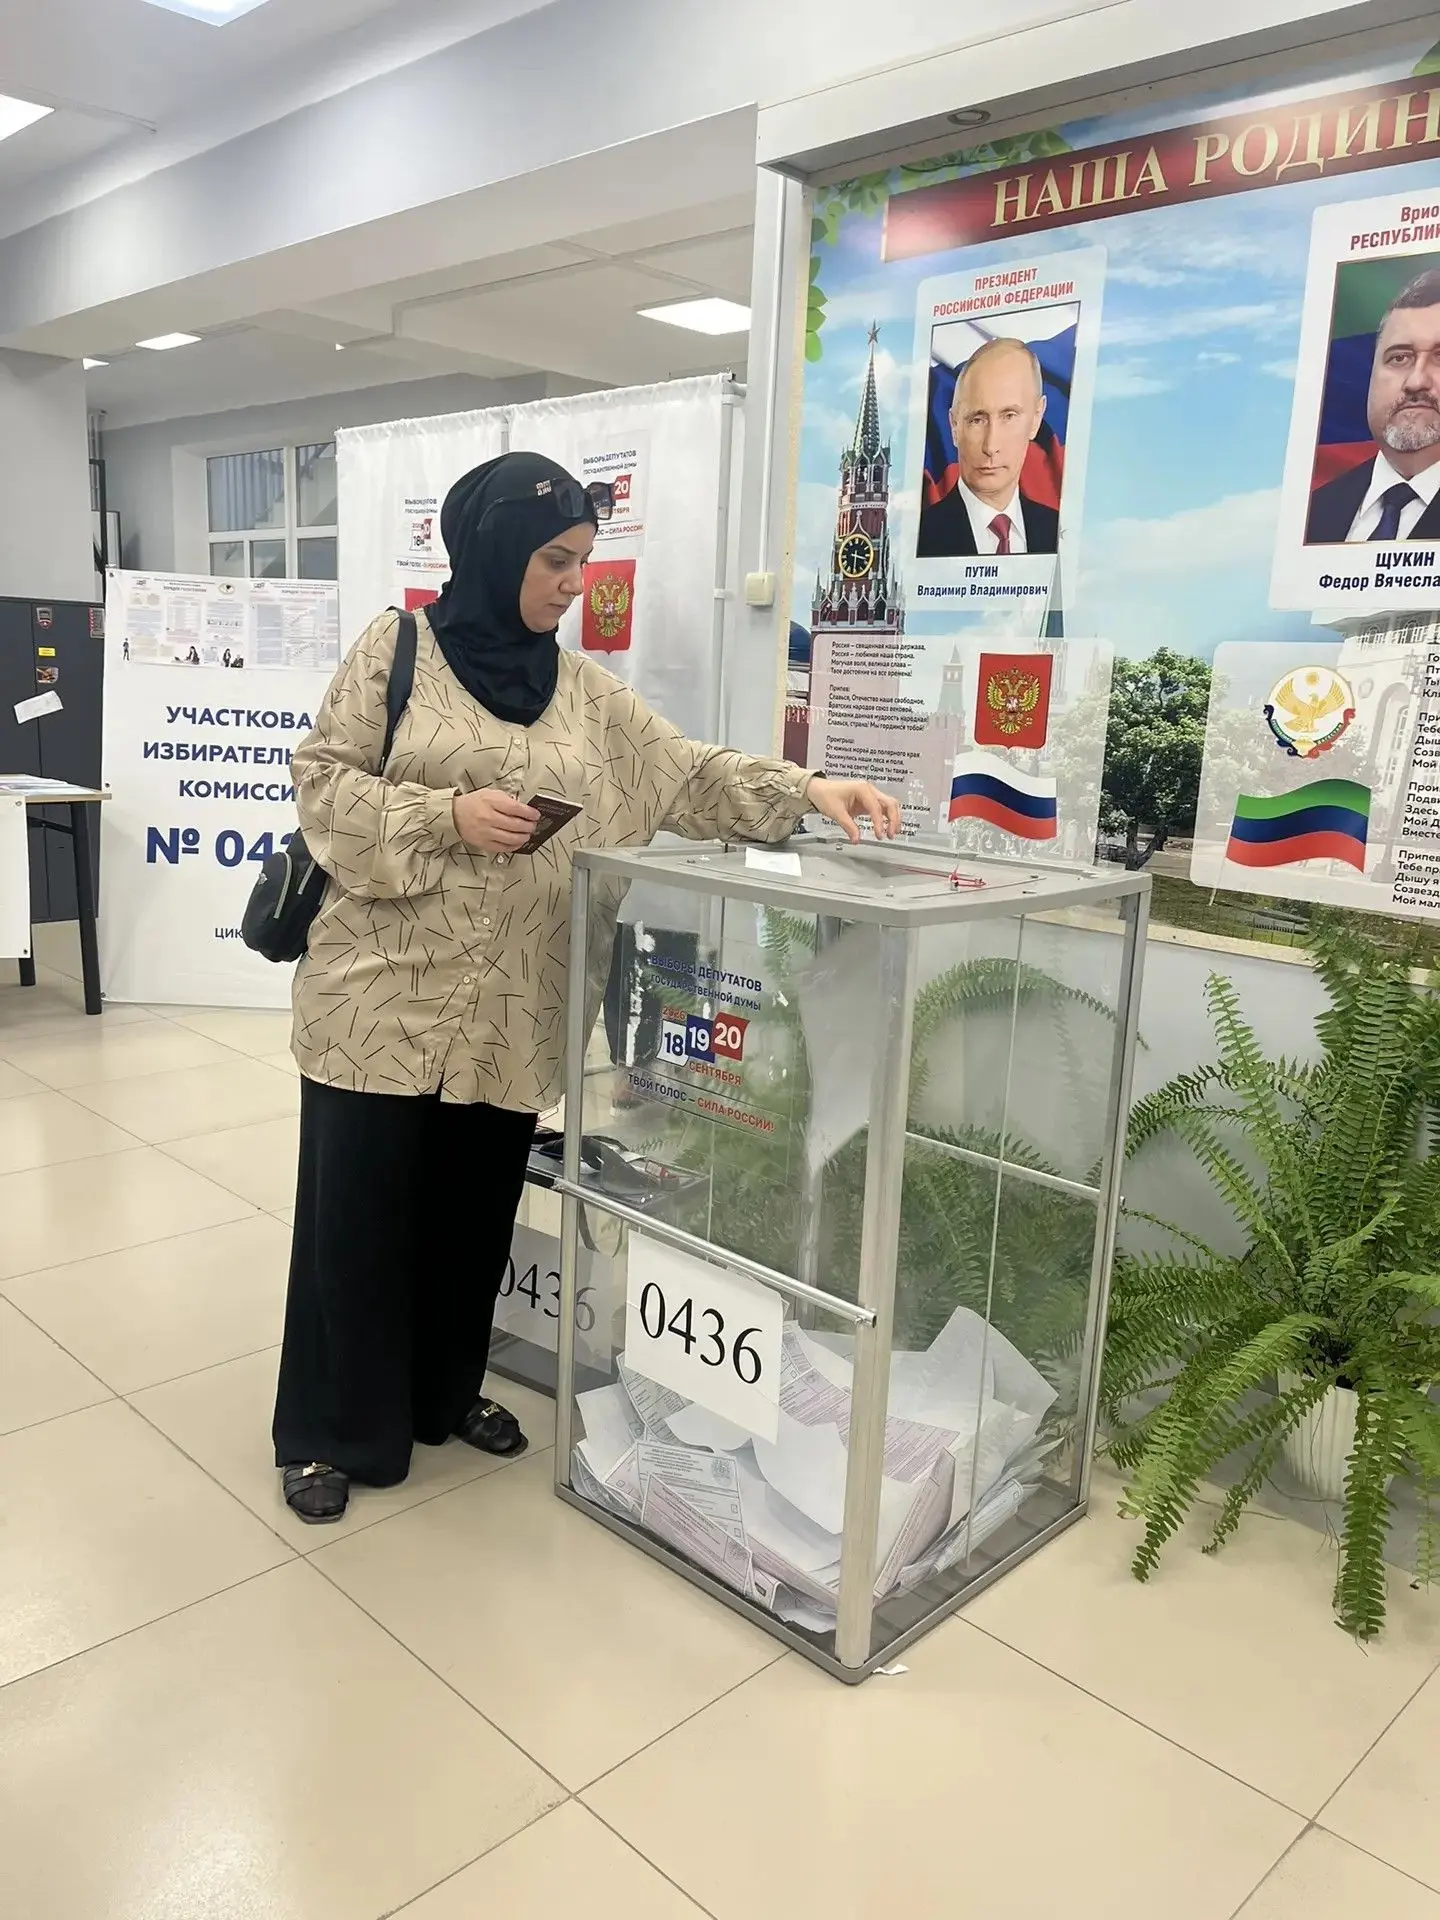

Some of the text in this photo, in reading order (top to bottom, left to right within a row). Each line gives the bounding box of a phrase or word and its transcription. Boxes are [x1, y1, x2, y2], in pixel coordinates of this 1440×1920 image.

[990, 89, 1440, 227] НАША РОДИН
[1401, 206, 1439, 224] Врио
[975, 268, 1038, 291] ПРЕЗИДЕНТ
[934, 281, 1074, 317] РОССИЙСКОЙ ФЕДЕРАЦИИ
[615, 481, 628, 495] 20
[1376, 552, 1435, 570] ЩУКИН
[965, 566, 998, 578] ПУТИН
[918, 584, 1048, 598] Владимир Владимирович
[1319, 574, 1440, 591] Федор Вячесла
[831, 659, 853, 667] Могучая
[829, 693, 851, 701] Славься,
[852, 694, 878, 702] Отечество
[166, 706, 313, 730] УЧАСТКОВА
[825, 761, 839, 769] Одна
[826, 752, 857, 761] Раскинулись
[1412, 760, 1437, 768] Мой
[179, 780, 298, 801] КОМИССИ
[1409, 782, 1440, 793] Прои
[1405, 804, 1439, 816] Здесь
[1404, 816, 1428, 827] Мой
[146, 827, 295, 868] № 04
[1398, 861, 1440, 875] Тебе пр
[1395, 872, 1430, 885] Дышу
[1392, 895, 1416, 905] Мой
[652, 955, 762, 992] ВЫБОРЫ ДЕПУТАТОВ
[650, 975, 761, 1011] ГОСУДАРСТВЕННОЙ ДУМЫ
[664, 1022, 741, 1056] 18 19 20
[689, 1061, 742, 1086] СЕНТЯБРЯ
[628, 1074, 653, 1089] ТВОЙ
[655, 1083, 687, 1102] ГОЛОС
[697, 1097, 725, 1115] СИЛА
[727, 1108, 775, 1133] РОССИИ!
[640, 1282, 763, 1385] 0436
